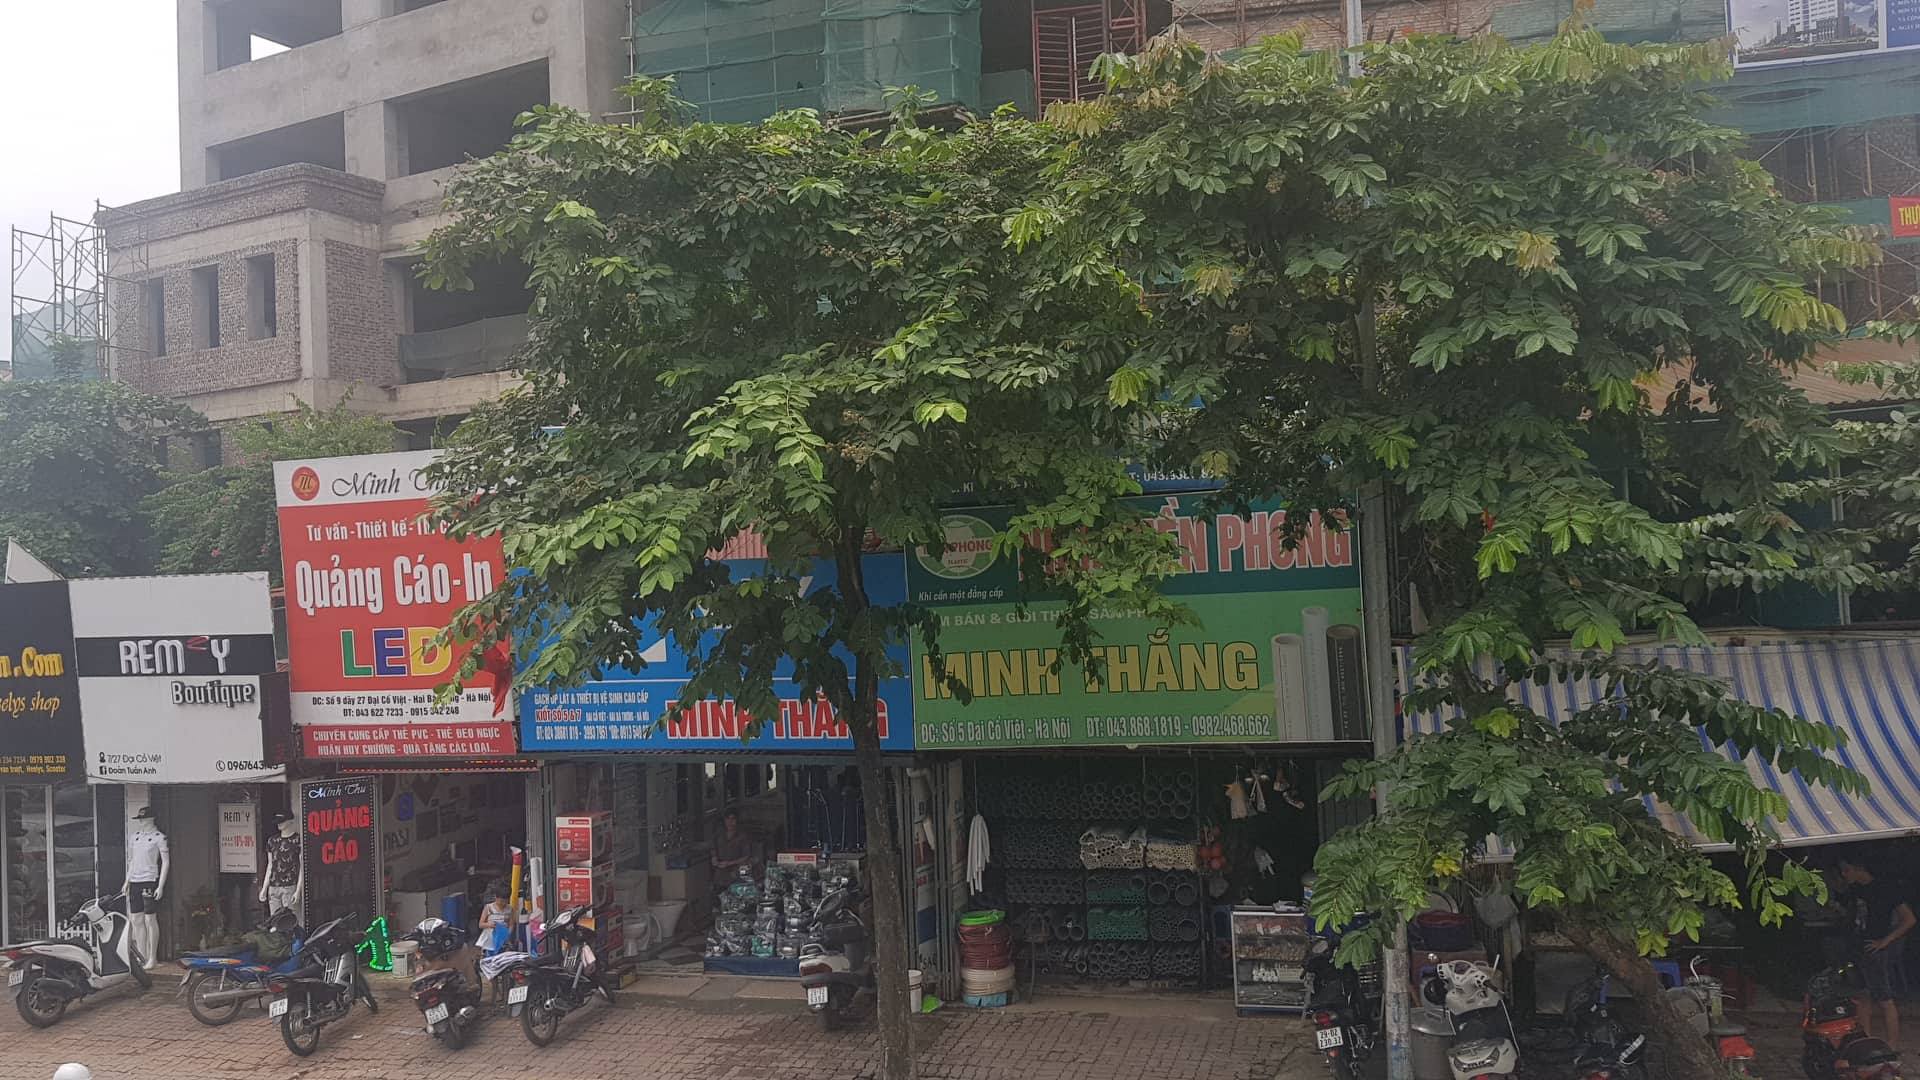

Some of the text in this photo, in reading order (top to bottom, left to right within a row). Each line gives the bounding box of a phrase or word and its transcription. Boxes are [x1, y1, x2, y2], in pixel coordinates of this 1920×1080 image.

[331, 468, 400, 497] Minh
[306, 522, 322, 541] Tư
[326, 520, 348, 541] vấn
[1217, 509, 1353, 572] PHONG
[295, 554, 384, 616] Quảng
[954, 611, 985, 626] BÁN
[990, 614, 1001, 624] &
[340, 626, 452, 678] LED
[920, 626, 1260, 702] MINH THẮNG
[0, 690, 60, 719] elys shop
[170, 680, 256, 708] Boutique
[326, 693, 336, 705] Số
[337, 696, 341, 704] 9
[357, 695, 366, 705] 27
[413, 693, 426, 704] Hai
[466, 692, 477, 702] Hà
[478, 692, 491, 703] Nội
[355, 708, 369, 717] 043
[370, 708, 385, 717] 622
[386, 708, 404, 717] 7233
[410, 707, 428, 717] 0915
[373, 725, 390, 740] CẤP
[411, 728, 429, 739] PVC
[921, 722, 940, 744] ĐC:
[941, 717, 957, 743] Số
[957, 722, 965, 741] 5
[968, 720, 987, 746] Đại
[1004, 718, 1026, 744] Việt
[1034, 718, 1050, 740] Hà
[1051, 718, 1070, 743] Nội
[1086, 717, 1104, 737] ĐT:
[1106, 716, 1182, 738] 043.868.1819
[1191, 714, 1271, 737] 0982.468.662
[343, 743, 360, 755] HUY
[308, 783, 367, 799] Minh Thu
[307, 799, 370, 835] QUẢNG
[321, 835, 359, 865] CÁO
